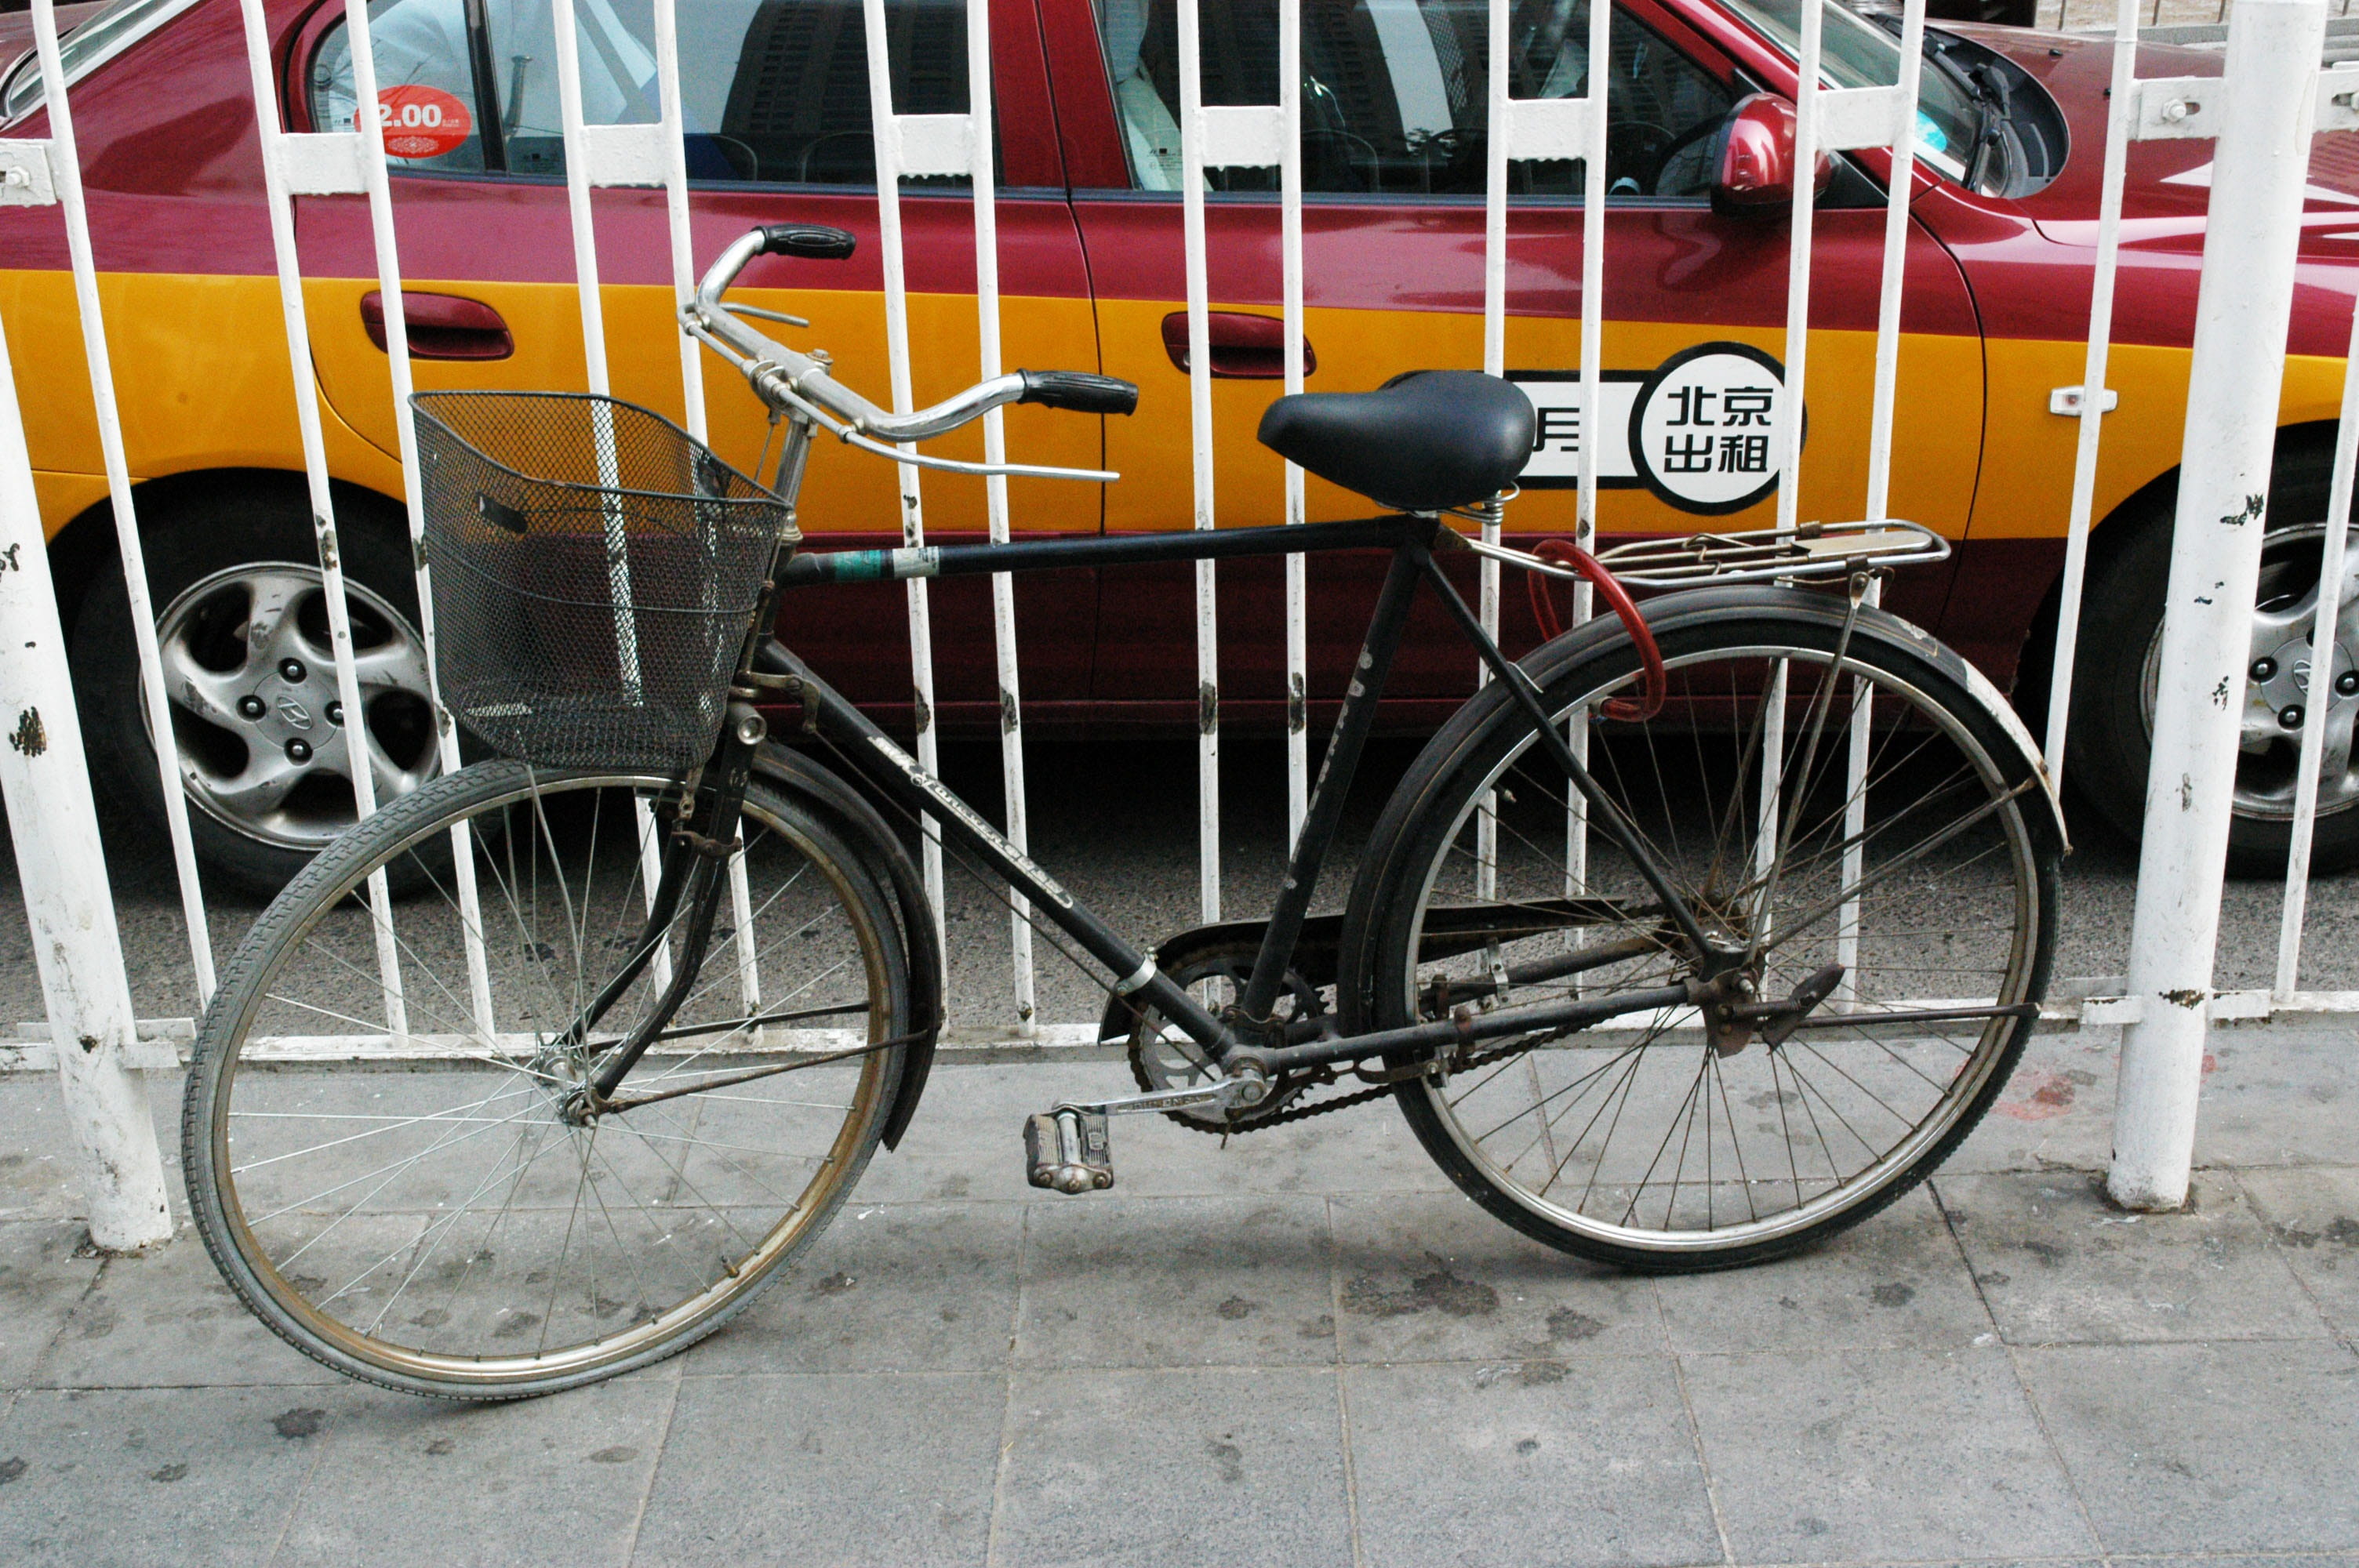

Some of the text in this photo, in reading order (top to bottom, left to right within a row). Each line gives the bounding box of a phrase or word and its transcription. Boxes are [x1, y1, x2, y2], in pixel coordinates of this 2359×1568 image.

[380, 103, 442, 128] 2.00
[1666, 386, 1774, 426] 北京
[1663, 434, 1769, 473] 出租
